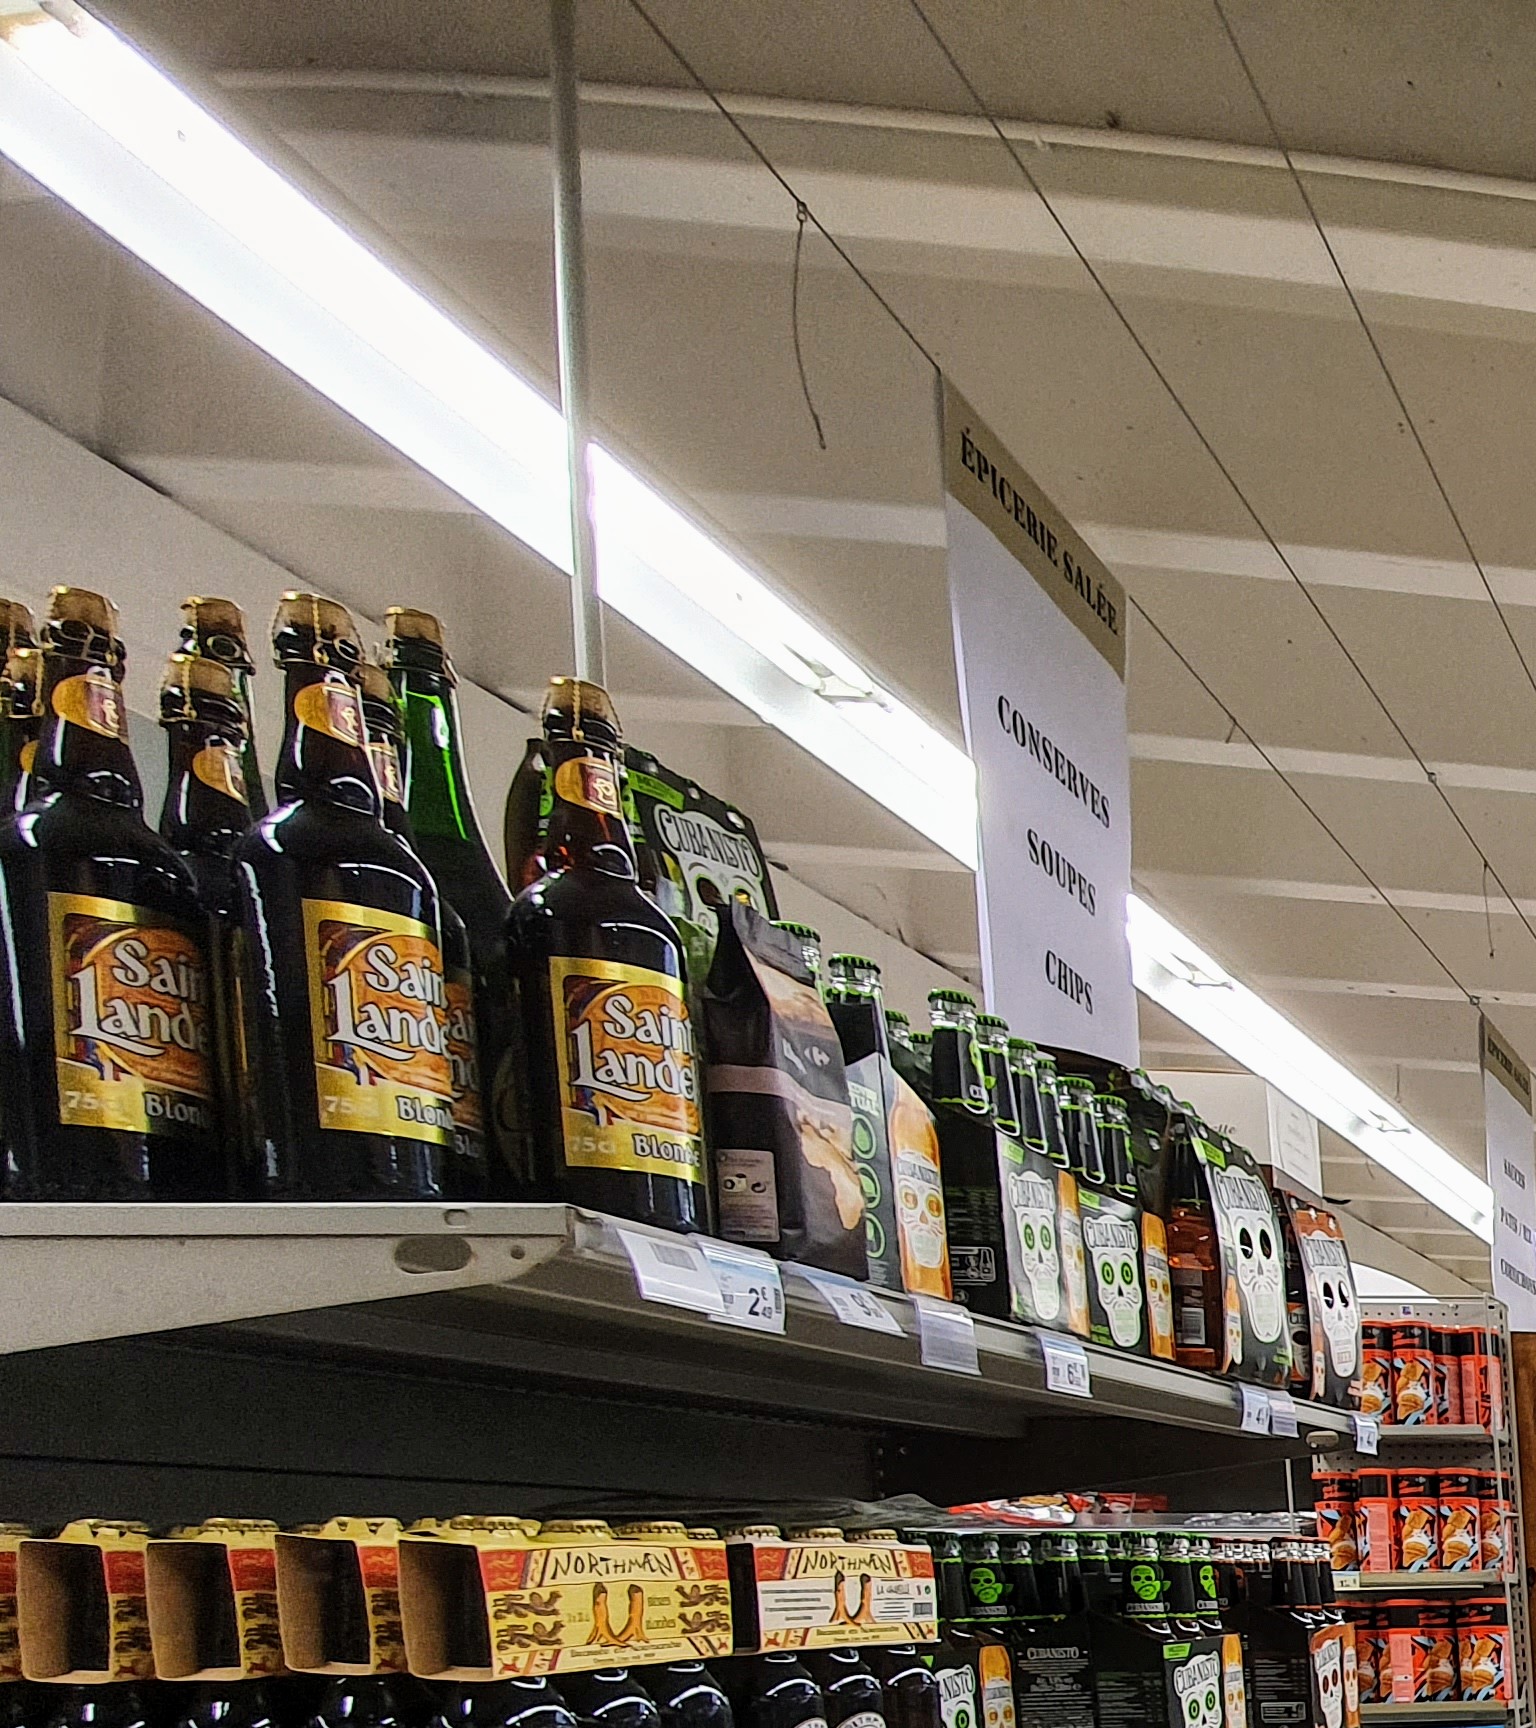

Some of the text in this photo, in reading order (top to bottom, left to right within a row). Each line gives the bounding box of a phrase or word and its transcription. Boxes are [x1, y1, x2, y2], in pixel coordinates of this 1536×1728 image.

[960, 426, 1119, 637] ÉPICERIE SALÉE
[998, 694, 1111, 829] CONSERVES
[658, 804, 760, 879] CUBANISTO
[1026, 827, 1096, 917] SOUPES
[1045, 949, 1093, 1016] CHIPS
[1173, 1655, 1219, 1695] CUBANISTO
